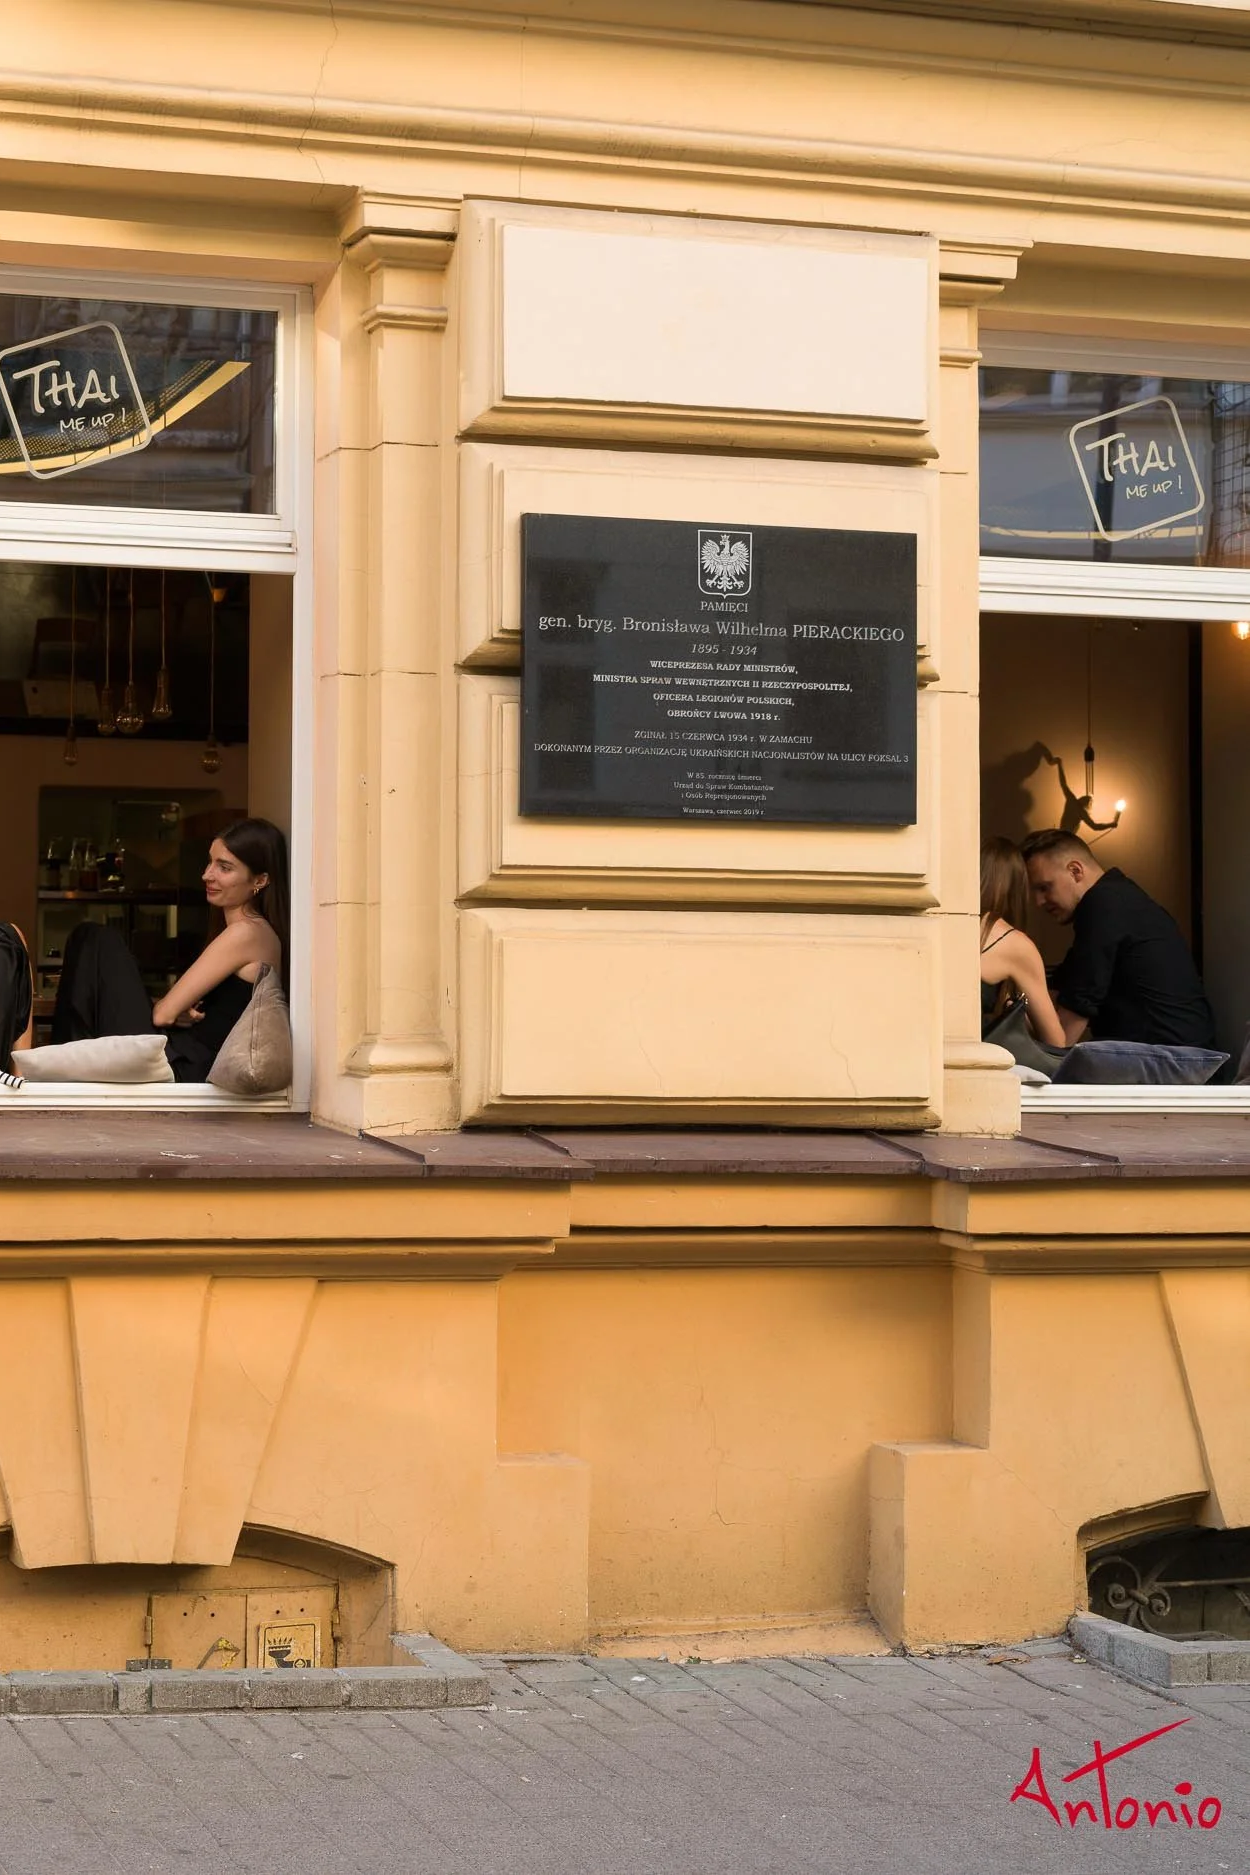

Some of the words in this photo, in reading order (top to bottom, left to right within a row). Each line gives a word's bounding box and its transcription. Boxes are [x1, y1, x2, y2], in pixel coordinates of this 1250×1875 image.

[12, 360, 120, 414] THAI
[60, 416, 86, 433] ME
[1085, 432, 1176, 482] THAI
[1126, 485, 1148, 499] ME
[700, 601, 748, 613] PAMIĘCI
[539, 615, 572, 630] gen.
[577, 614, 617, 633] bryg.
[622, 616, 710, 634] Bronisława
[716, 621, 787, 637] Wilhelma
[793, 624, 905, 641] PIERACKIEGO
[691, 644, 719, 654] 1895
[729, 645, 758, 655] 1934
[650, 660, 714, 671] WICEPREZESA
[716, 663, 741, 672] RADY
[743, 663, 799, 674] MINISTRÓW,
[593, 674, 638, 684] MINISTRA
[640, 676, 672, 685] SPRAW
[674, 677, 750, 688] WEWNĘTRZNYCH
[752, 680, 760, 688] II
[762, 681, 853, 693] RZECZYPOSPOLITEJ,
[653, 693, 693, 702] OFICERA
[696, 693, 744, 704] LEGIONÓW
[746, 696, 795, 706] POLSKICH,
[667, 708, 711, 719] OBROŃCY
[713, 712, 747, 720] LWOWA
[750, 713, 771, 721] 1918
[670, 732, 680, 740] 15
[681, 732, 725, 741] CZERWCA
[728, 734, 748, 742] 1934
[759, 735, 767, 743] W
[769, 736, 813, 744] ZAMACHU
[534, 743, 592, 753] DOKONANYM
[594, 745, 623, 754] PRZEZ
[624, 746, 688, 757] ORGANIZACJĘ
[689, 748, 749, 759] UKRAIŃSKICH
[751, 750, 825, 761] NACJONALISTÓW
[827, 752, 839, 761] NA
[841, 753, 866, 762] ULICY
[868, 754, 901, 763] FOKSAL
[903, 755, 909, 763] 3
[705, 782, 727, 791] Spraw
[685, 791, 703, 799] Osób
[704, 792, 767, 802] Represjonowanych
[682, 807, 716, 815] Warszawa,
